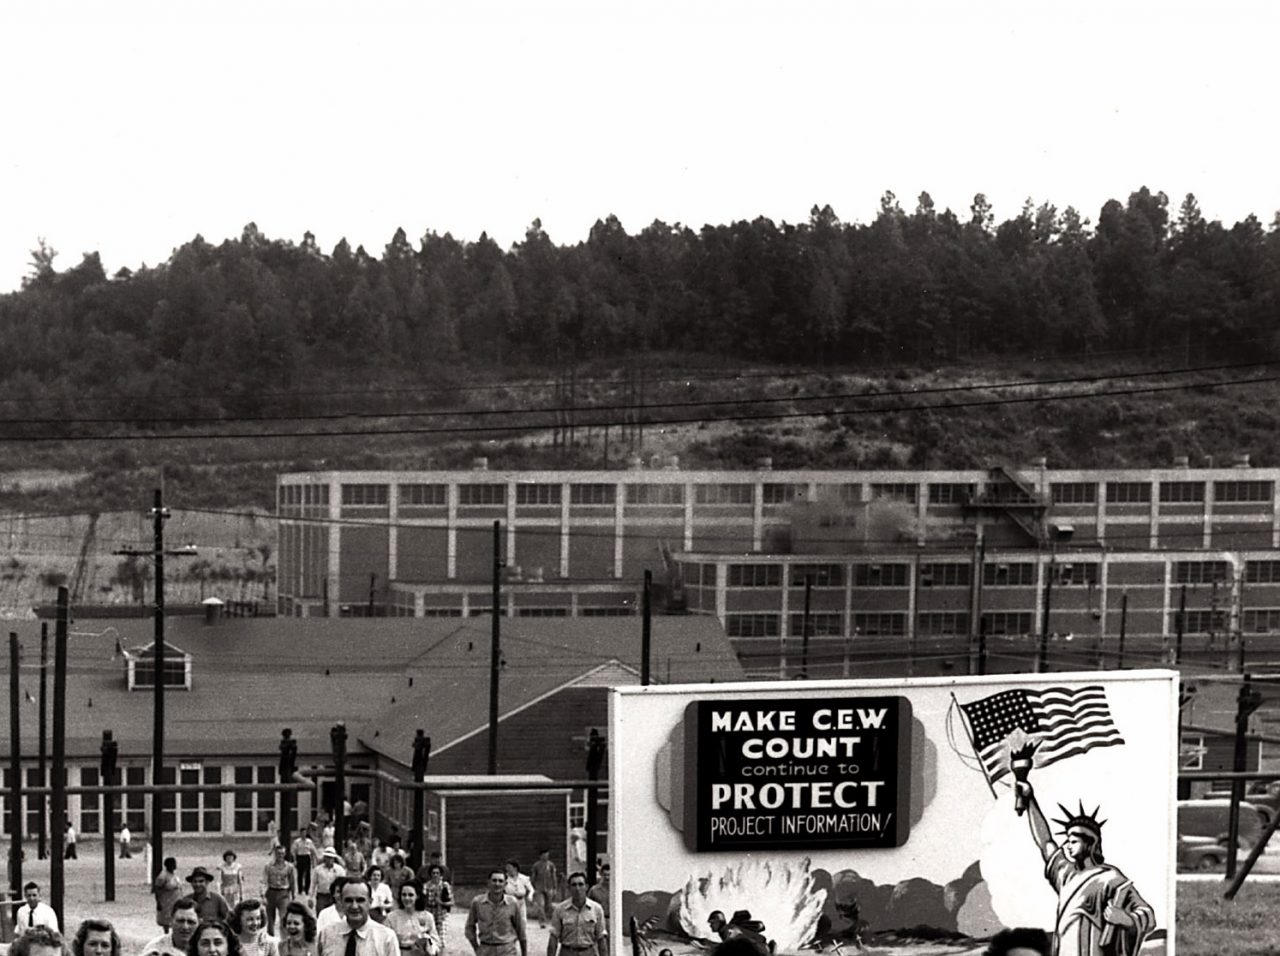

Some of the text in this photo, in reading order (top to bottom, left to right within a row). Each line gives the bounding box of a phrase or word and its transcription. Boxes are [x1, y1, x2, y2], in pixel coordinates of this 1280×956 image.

[711, 708, 888, 732] MAKE C.E.W.
[741, 736, 862, 759] COUNT
[741, 760, 860, 776] continue to
[711, 780, 885, 810] PROTECT
[710, 812, 892, 844] PROJECT INFORMATION!
